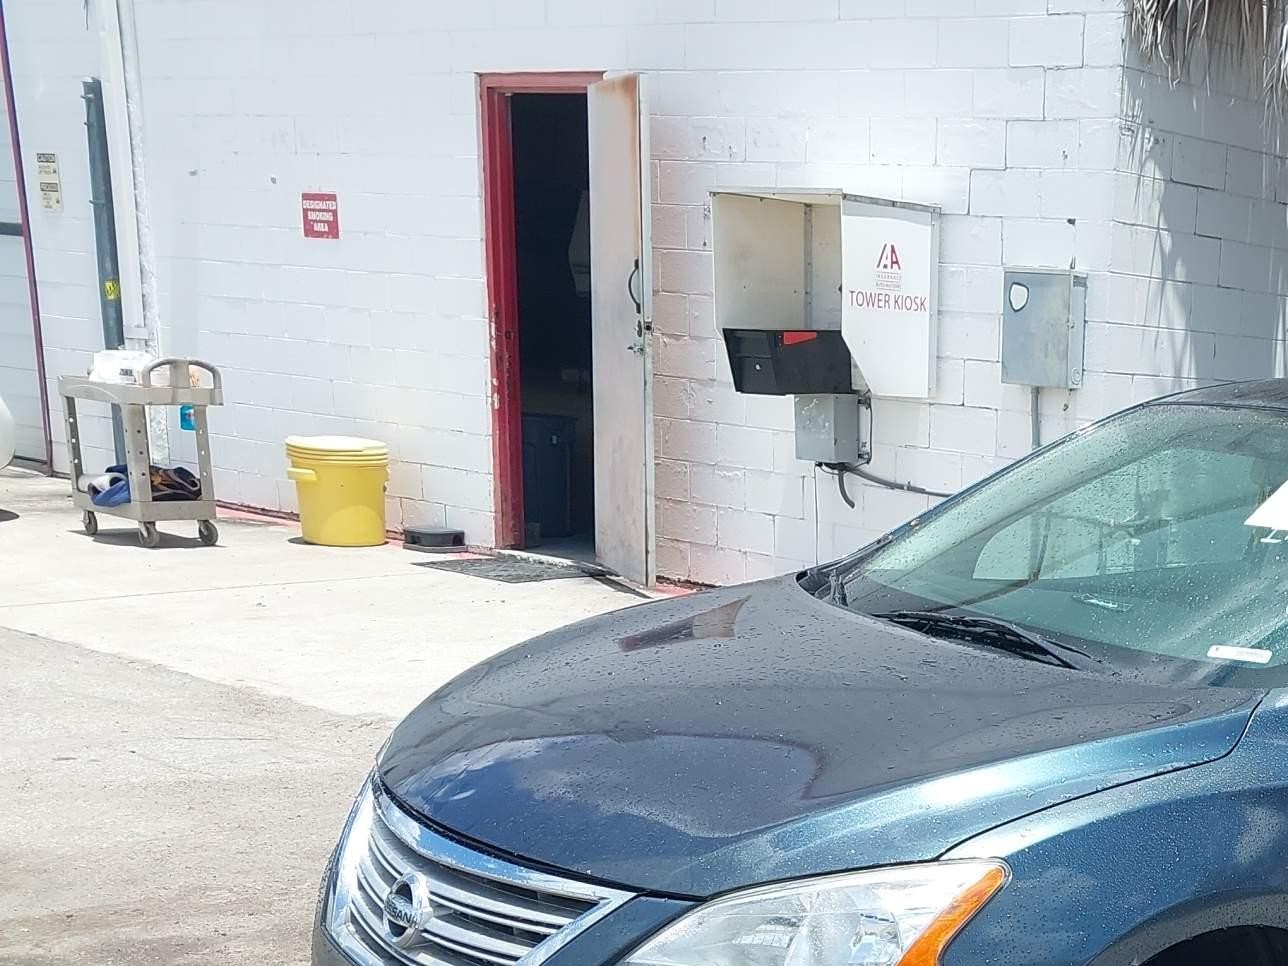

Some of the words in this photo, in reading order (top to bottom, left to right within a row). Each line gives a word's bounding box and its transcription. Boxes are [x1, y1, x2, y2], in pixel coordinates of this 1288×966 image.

[303, 200, 336, 210] DESIGNATED
[308, 211, 333, 221] SMOKING
[314, 222, 328, 232] AREA
[849, 290, 891, 310] TOWER
[894, 294, 927, 312] KIOSK
